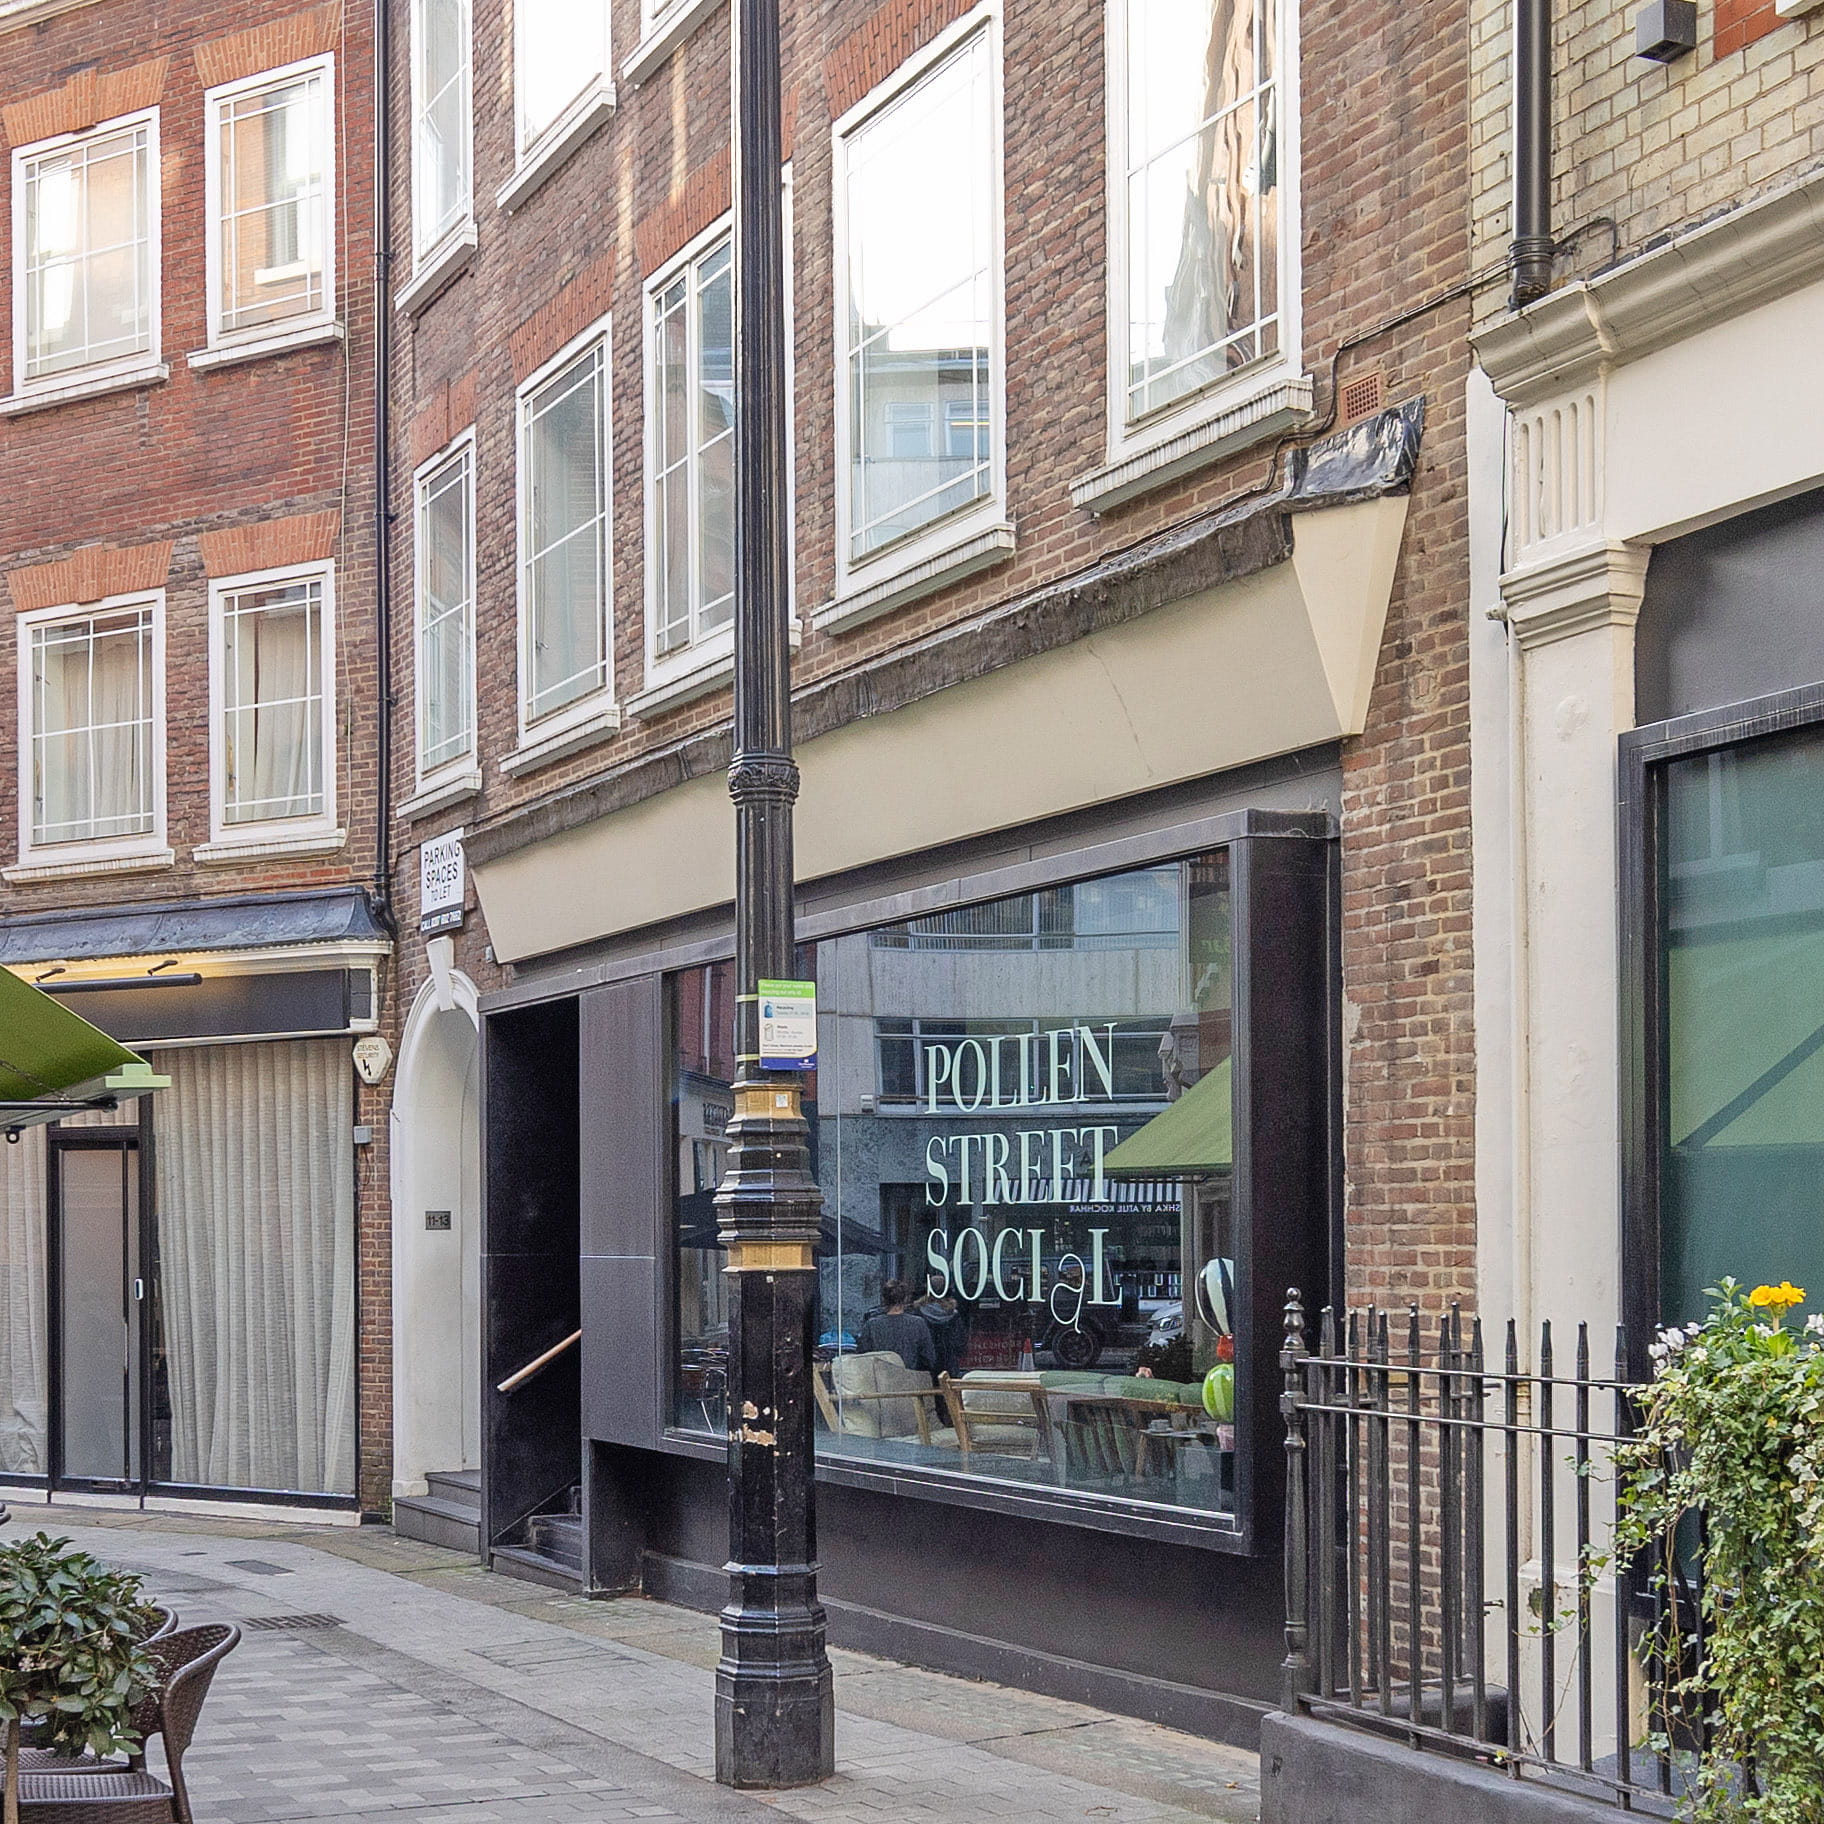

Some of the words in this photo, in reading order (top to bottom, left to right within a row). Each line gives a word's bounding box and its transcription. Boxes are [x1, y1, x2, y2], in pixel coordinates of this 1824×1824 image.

[424, 839, 461, 868] PARKING
[426, 861, 458, 889] SPACES
[431, 888, 439, 902] TO
[439, 884, 452, 900] LET
[924, 1022, 1118, 1114] POLLEN
[926, 1125, 1119, 1207] STREET
